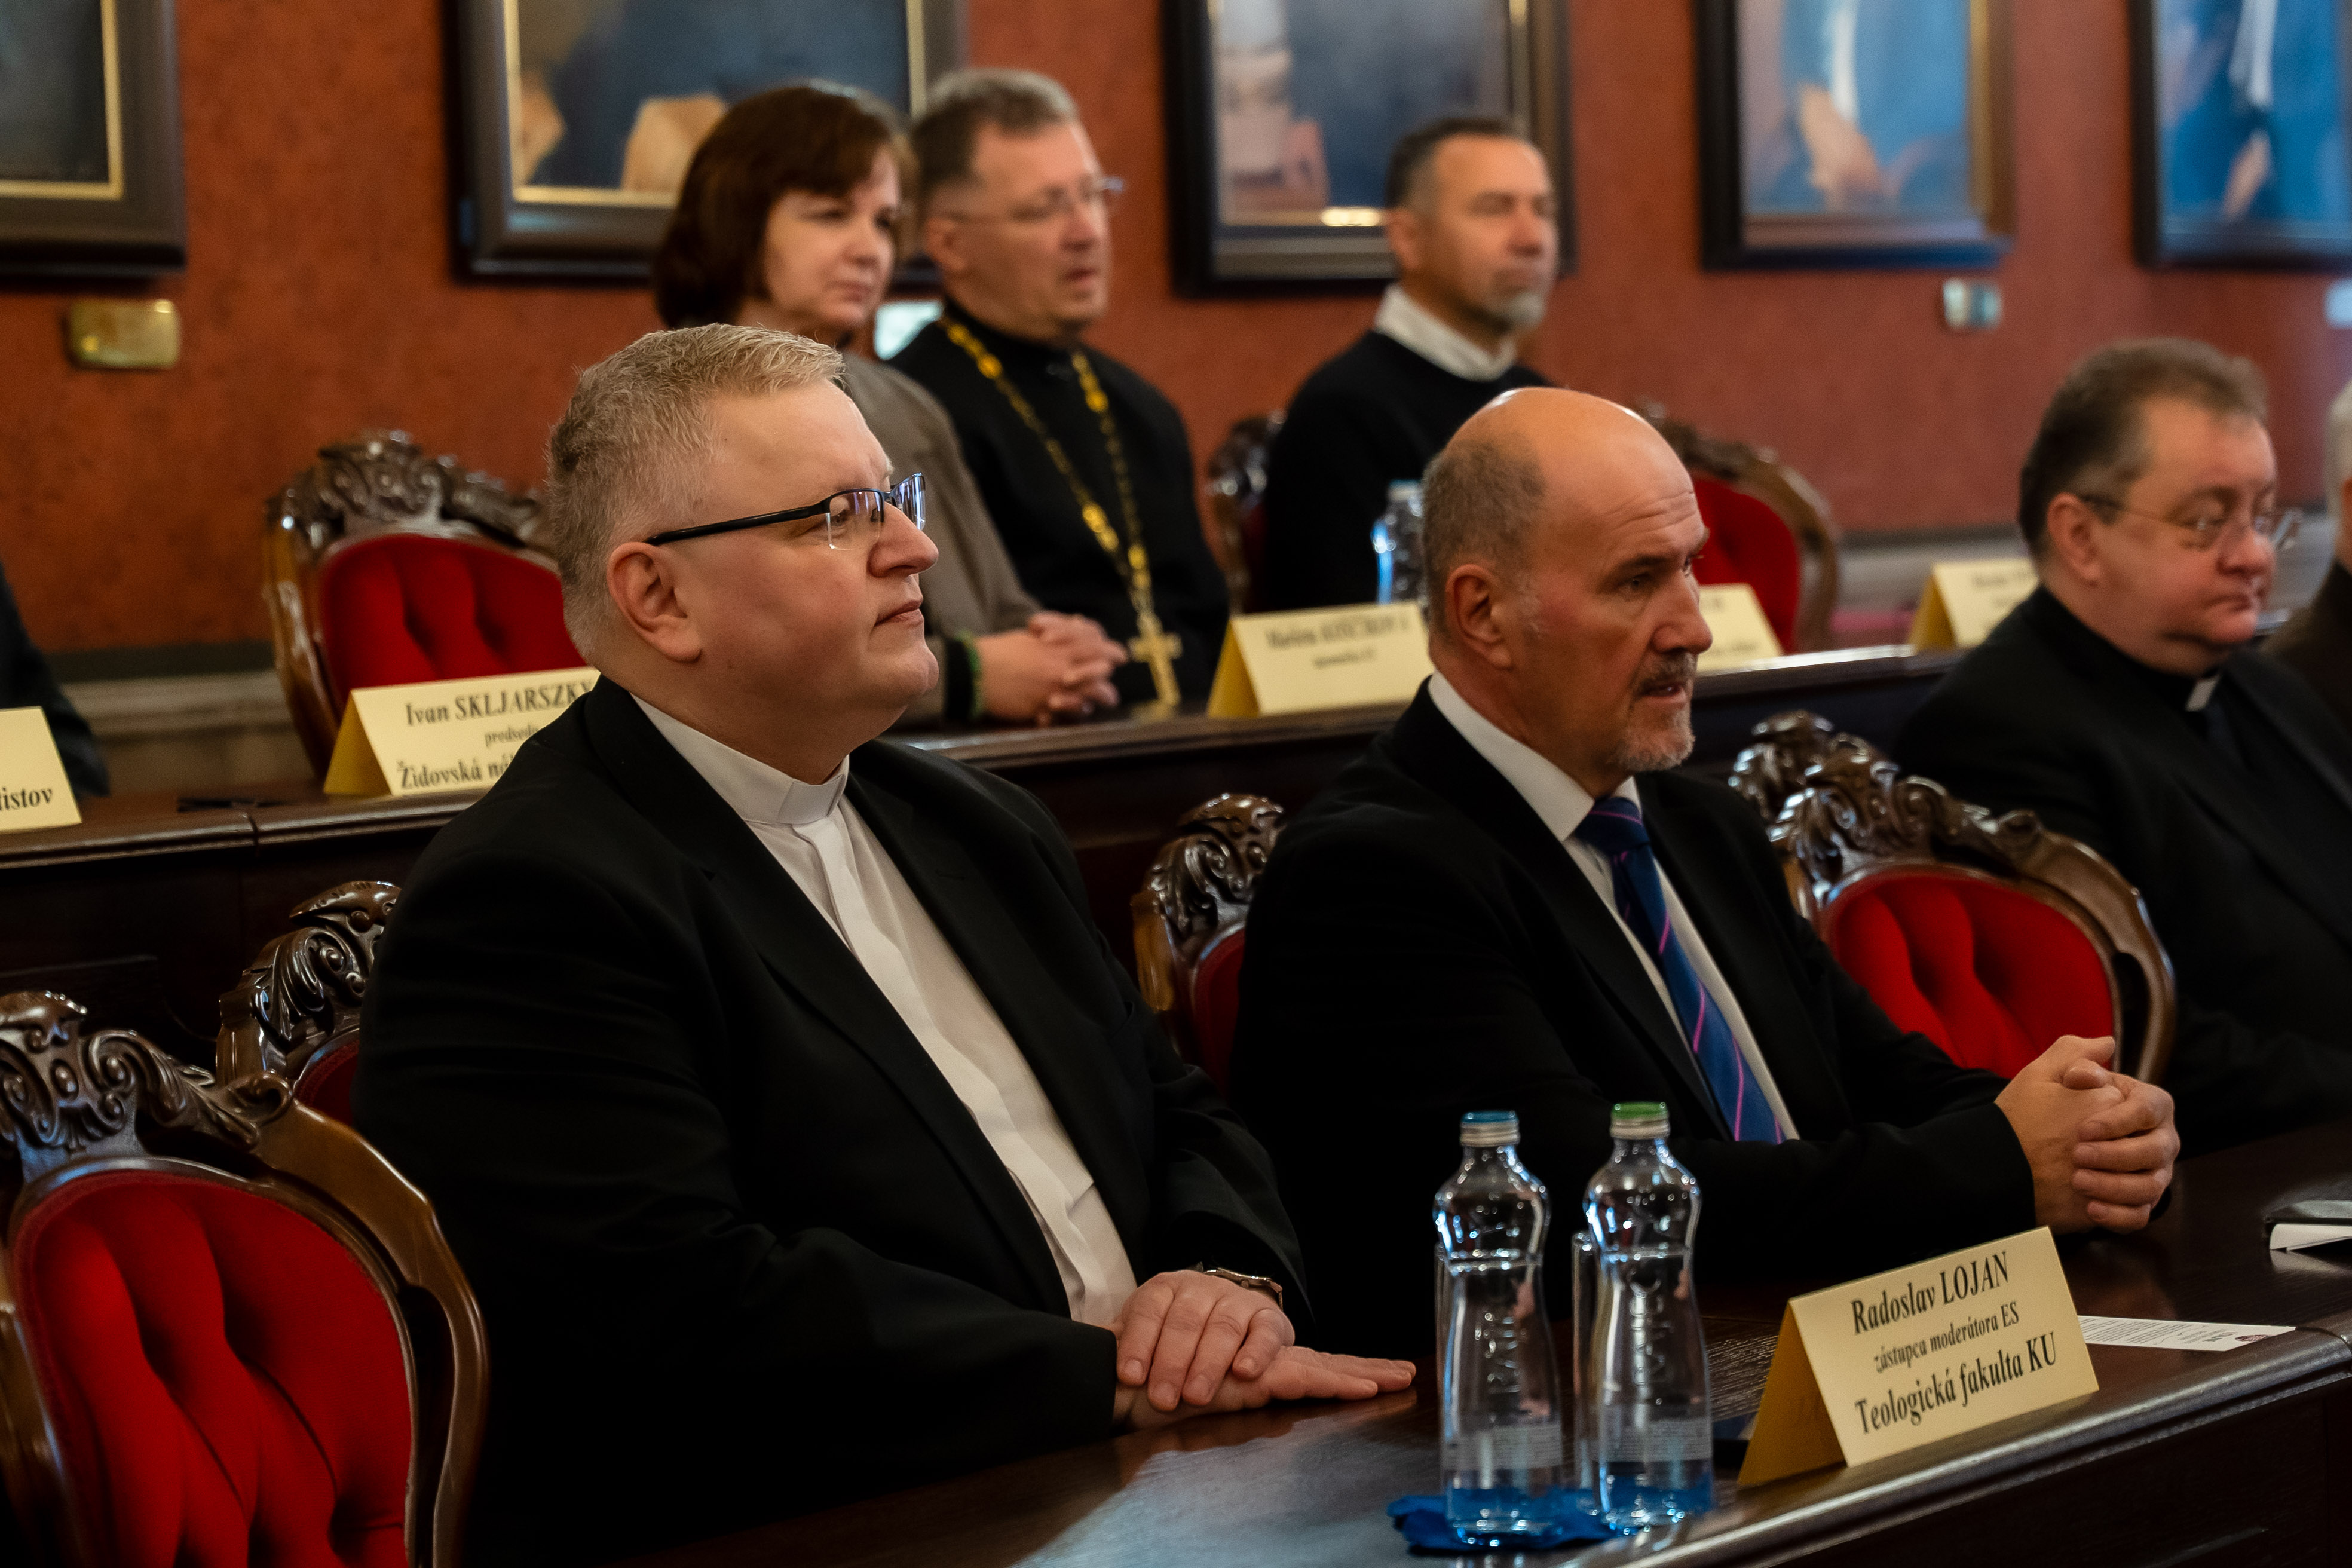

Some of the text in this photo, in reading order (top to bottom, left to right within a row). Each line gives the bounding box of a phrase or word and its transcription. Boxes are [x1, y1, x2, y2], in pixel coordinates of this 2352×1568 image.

[406, 702, 448, 726] Ivan
[0, 786, 53, 811] istov
[397, 759, 481, 790] Židovská
[1851, 1251, 2008, 1335] Radoslav LOJAN
[1873, 1301, 2020, 1374] zástupca moderátora ES
[1854, 1331, 2057, 1434] Teologická fakulta KU
